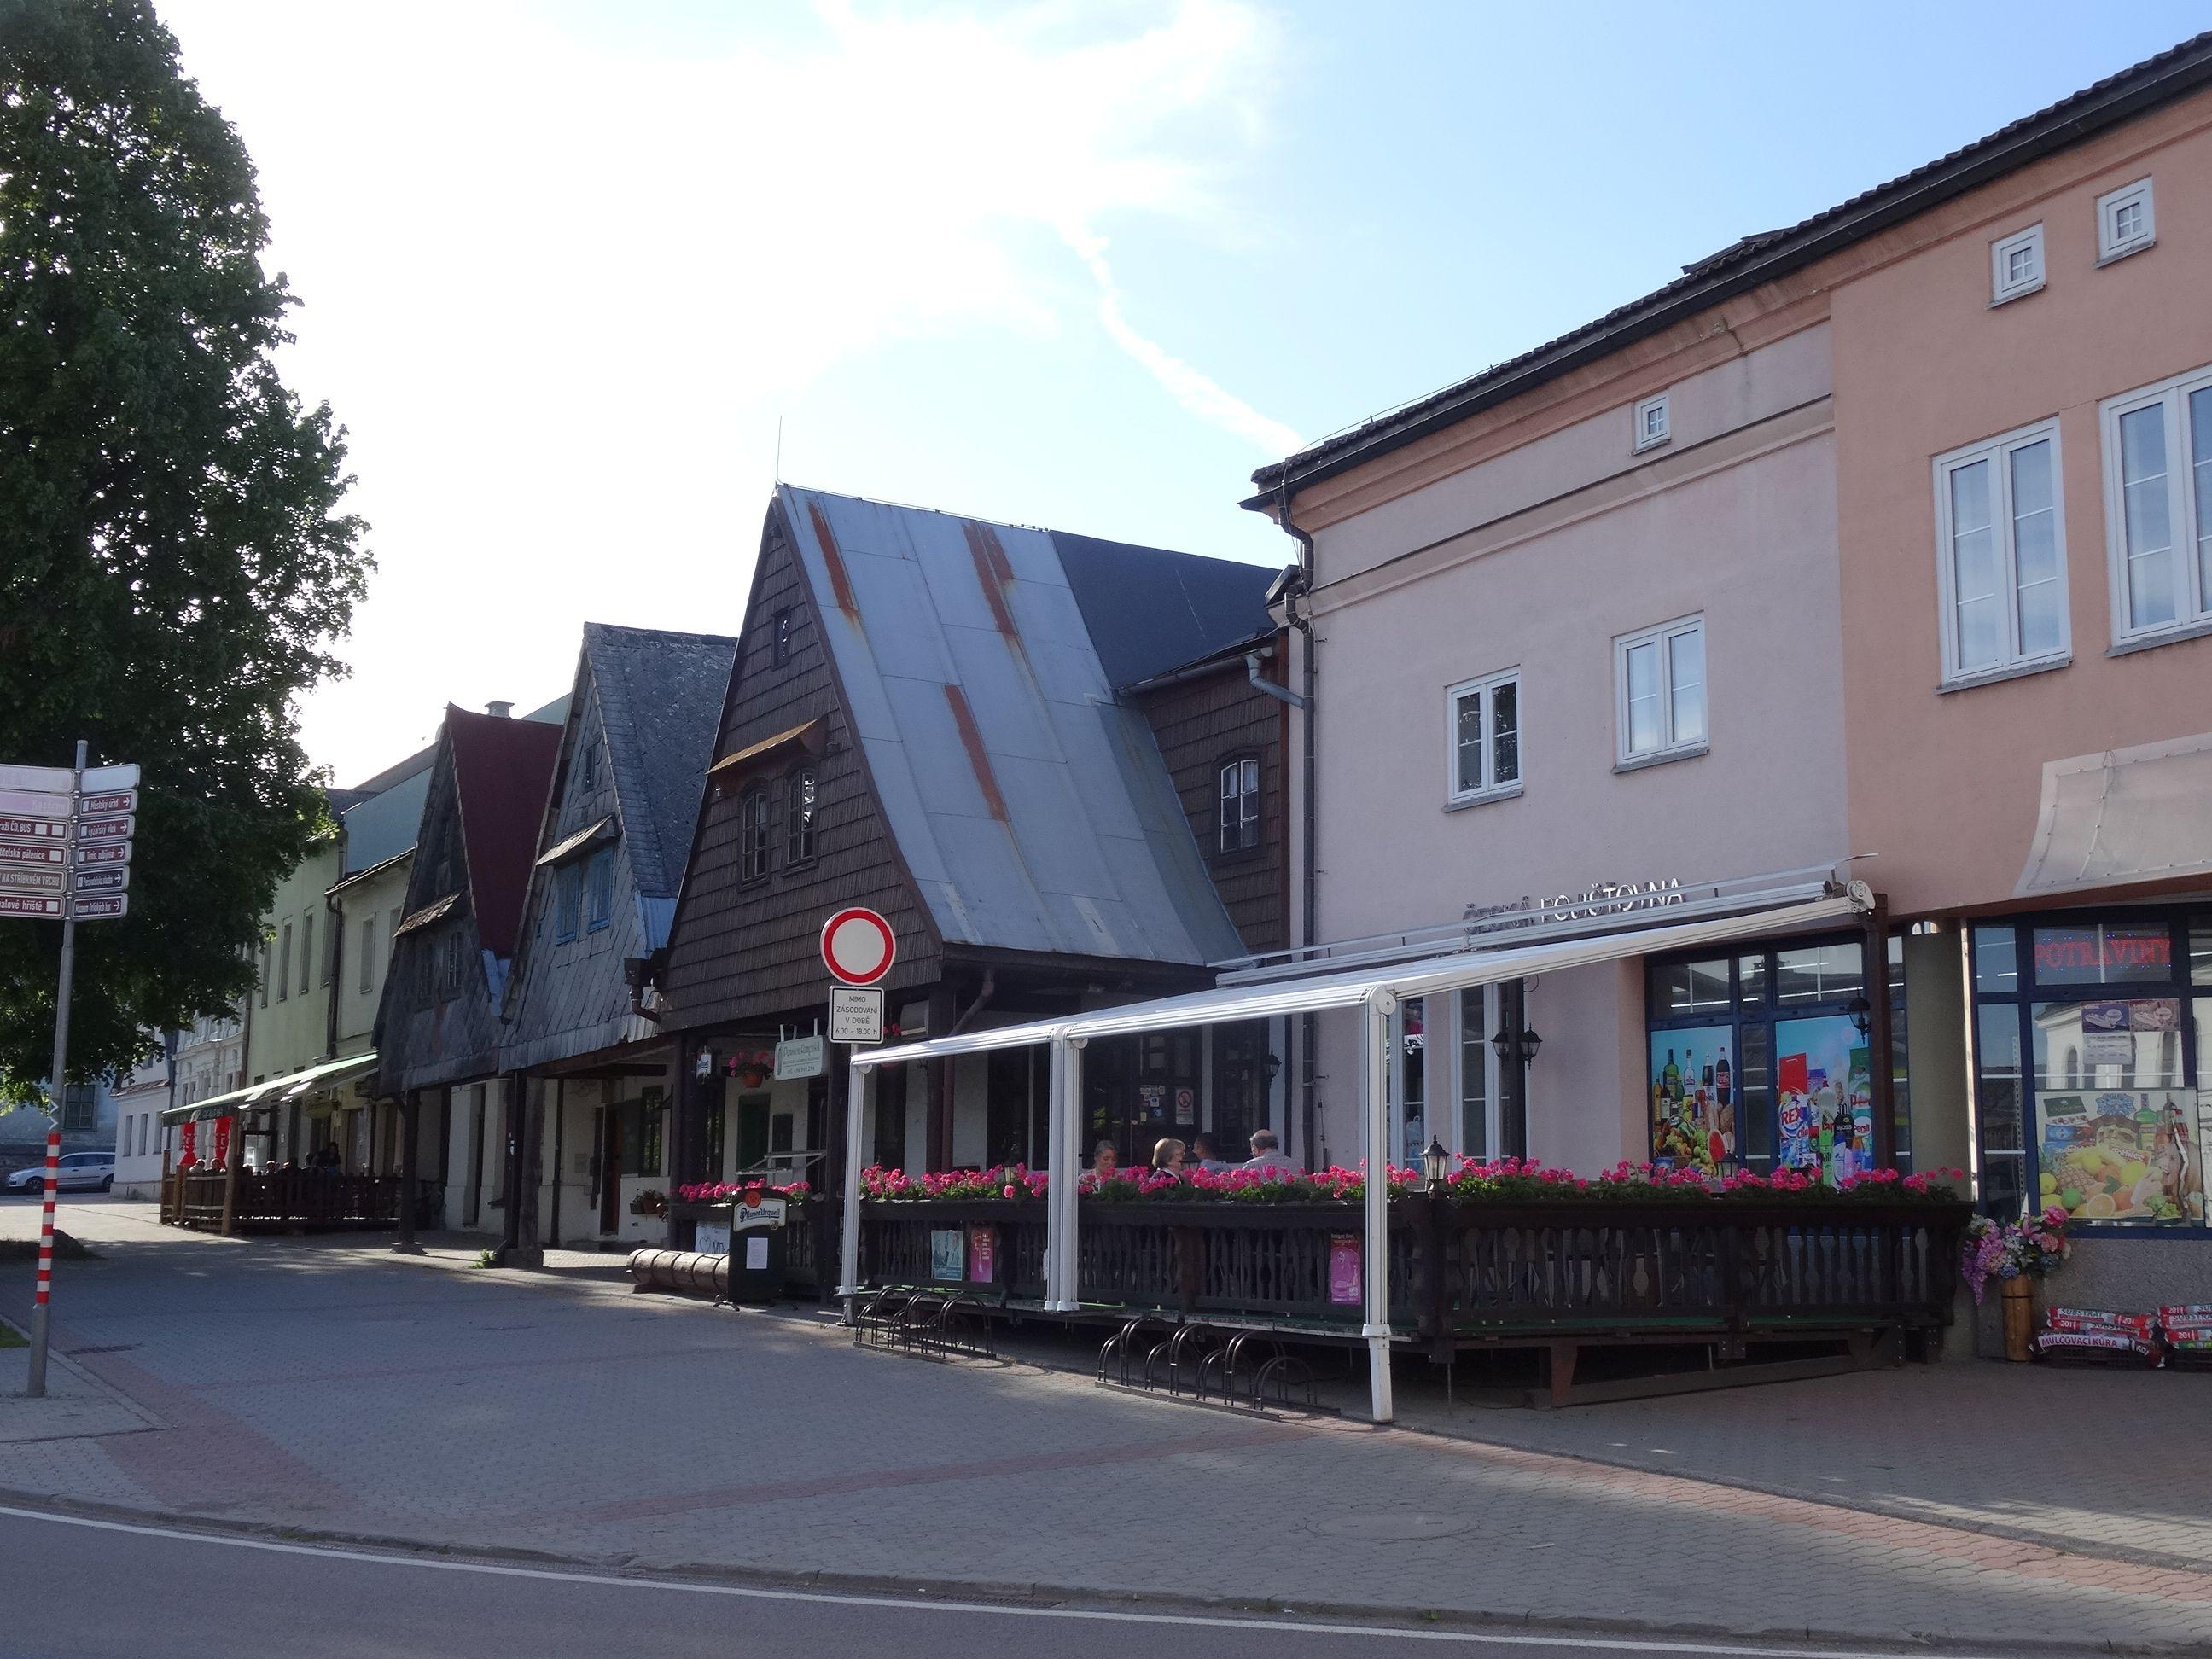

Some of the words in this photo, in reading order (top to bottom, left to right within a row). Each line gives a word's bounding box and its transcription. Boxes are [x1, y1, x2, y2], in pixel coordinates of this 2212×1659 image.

[836, 1004, 878, 1014] ZÁSOBOVÁNÍ
[852, 1016, 870, 1024] DOBĚ
[1781, 1106, 1802, 1125] REX
[740, 1208, 760, 1222] Pilsner
[760, 1208, 780, 1219] Urquell
[2041, 1334, 2091, 1347] MULČOVACÍ
